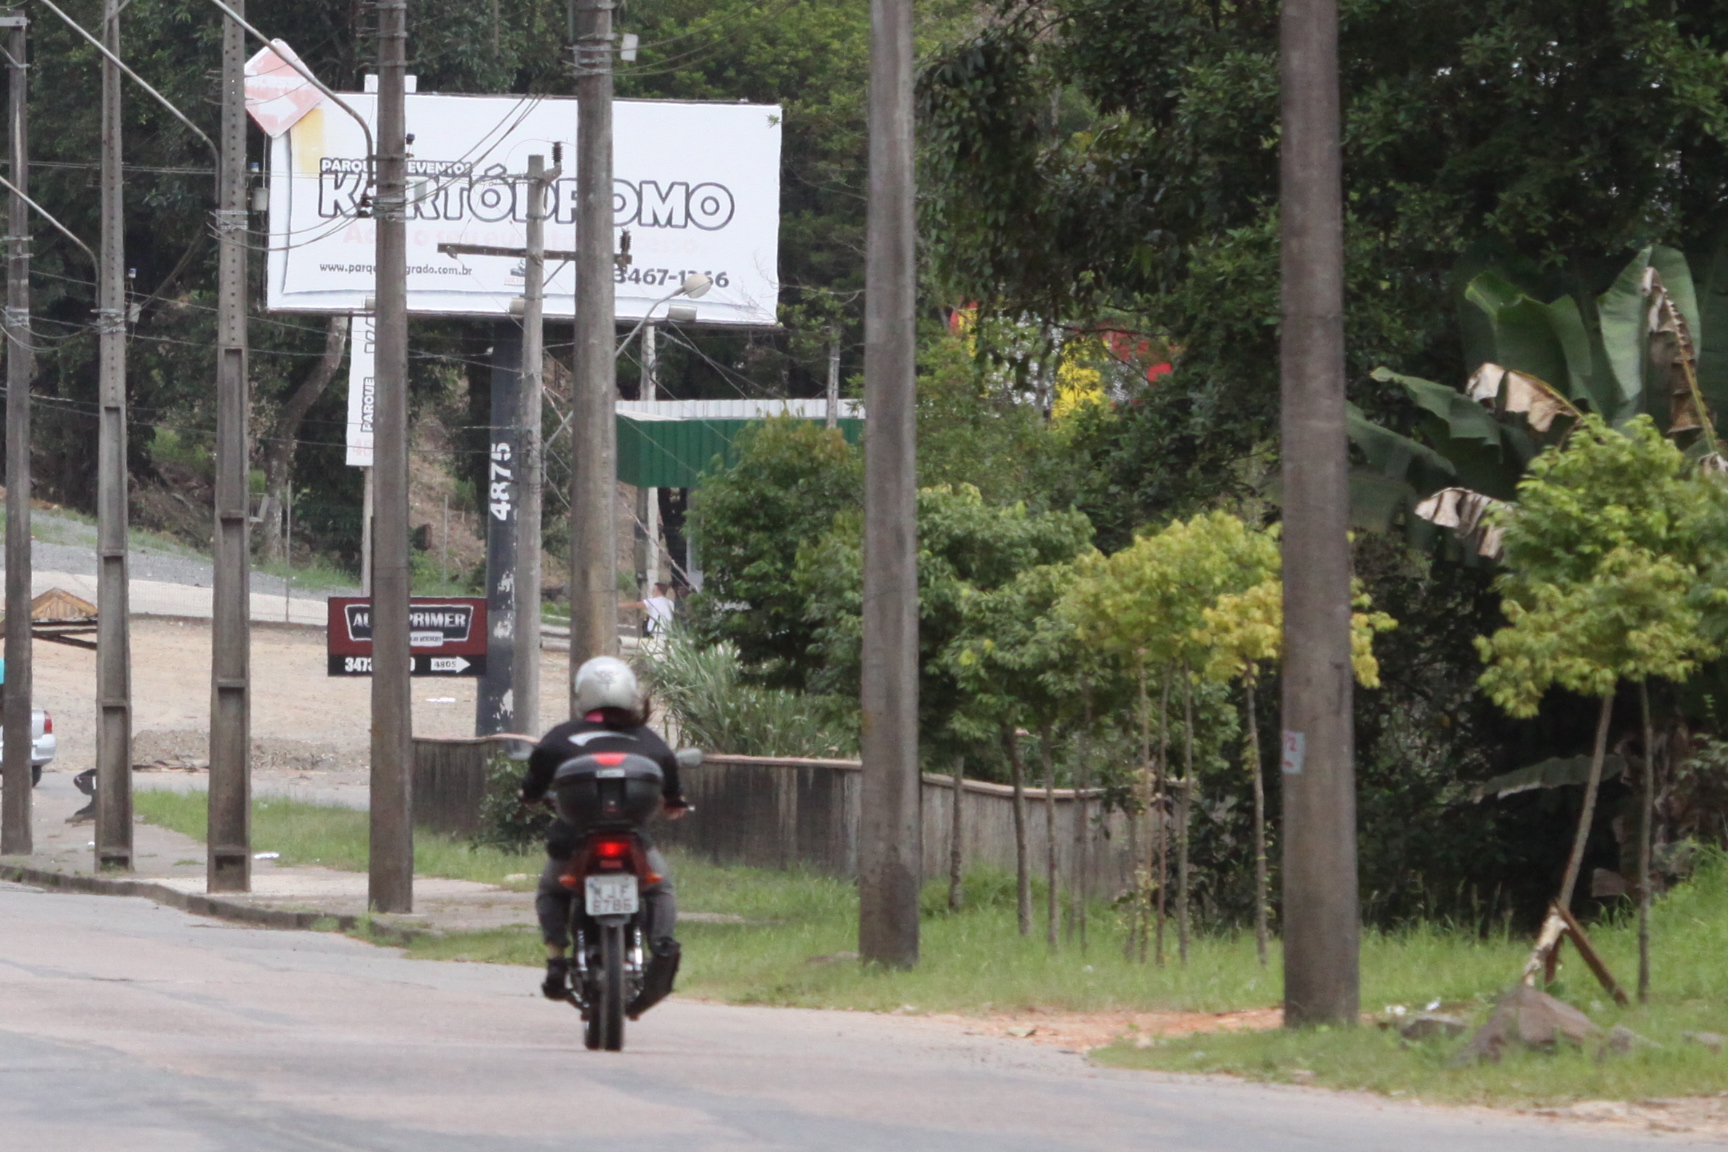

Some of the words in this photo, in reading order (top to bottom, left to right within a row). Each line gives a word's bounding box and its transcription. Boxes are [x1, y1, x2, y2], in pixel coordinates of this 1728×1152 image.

[318, 163, 735, 231] KRTÓDOMO
[614, 268, 729, 288] 3467-16
[490, 442, 512, 521] 4875
